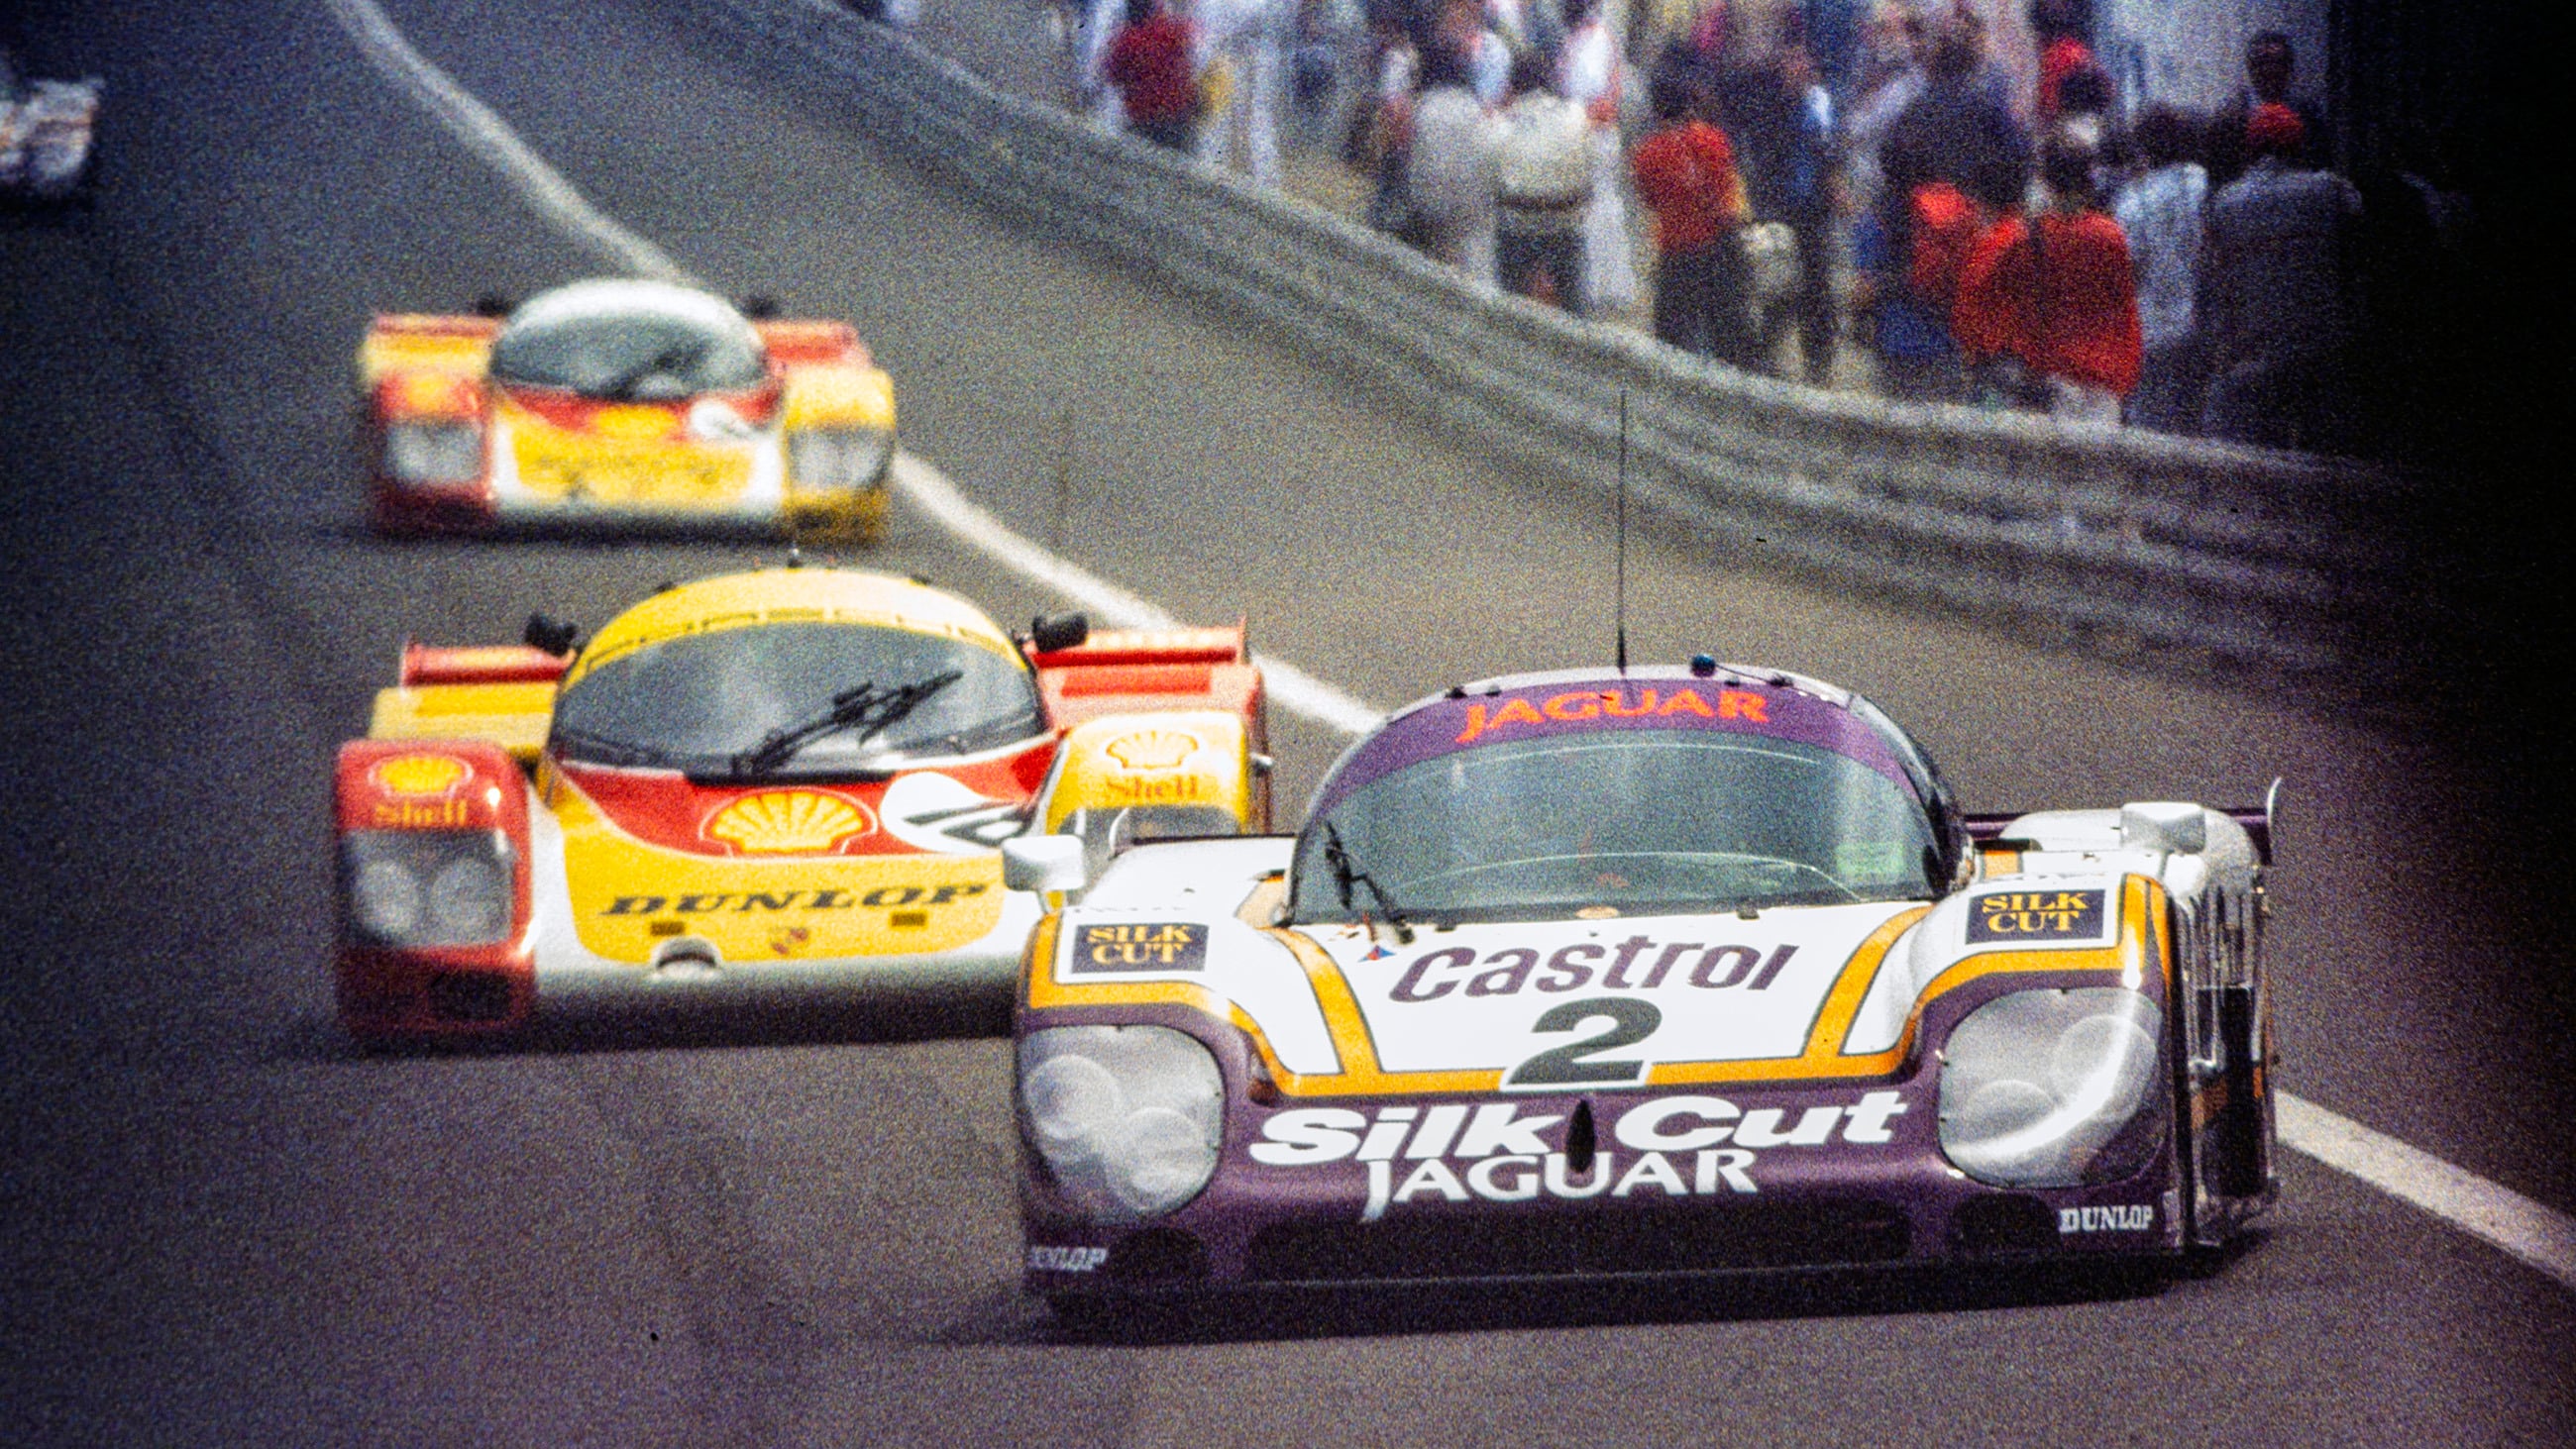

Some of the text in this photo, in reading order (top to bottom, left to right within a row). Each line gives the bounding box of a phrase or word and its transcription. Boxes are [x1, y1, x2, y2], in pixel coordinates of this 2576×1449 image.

[1454, 688, 1771, 743] JAGUAR
[1105, 774, 1198, 798] Shell
[374, 798, 468, 827] Shell
[597, 883, 989, 916] DUNLOP
[1982, 892, 2090, 913] SILK
[1086, 925, 1193, 943] SILK
[1987, 910, 2080, 933] CUT
[1092, 943, 1184, 965] CUT
[1388, 934, 1800, 1003] Castrol
[1507, 996, 1663, 1086] 2
[1249, 1091, 1909, 1166] Silk Cut
[1360, 1150, 1760, 1222] JAGUAR
[2058, 1204, 2154, 1233] DUNLOP
